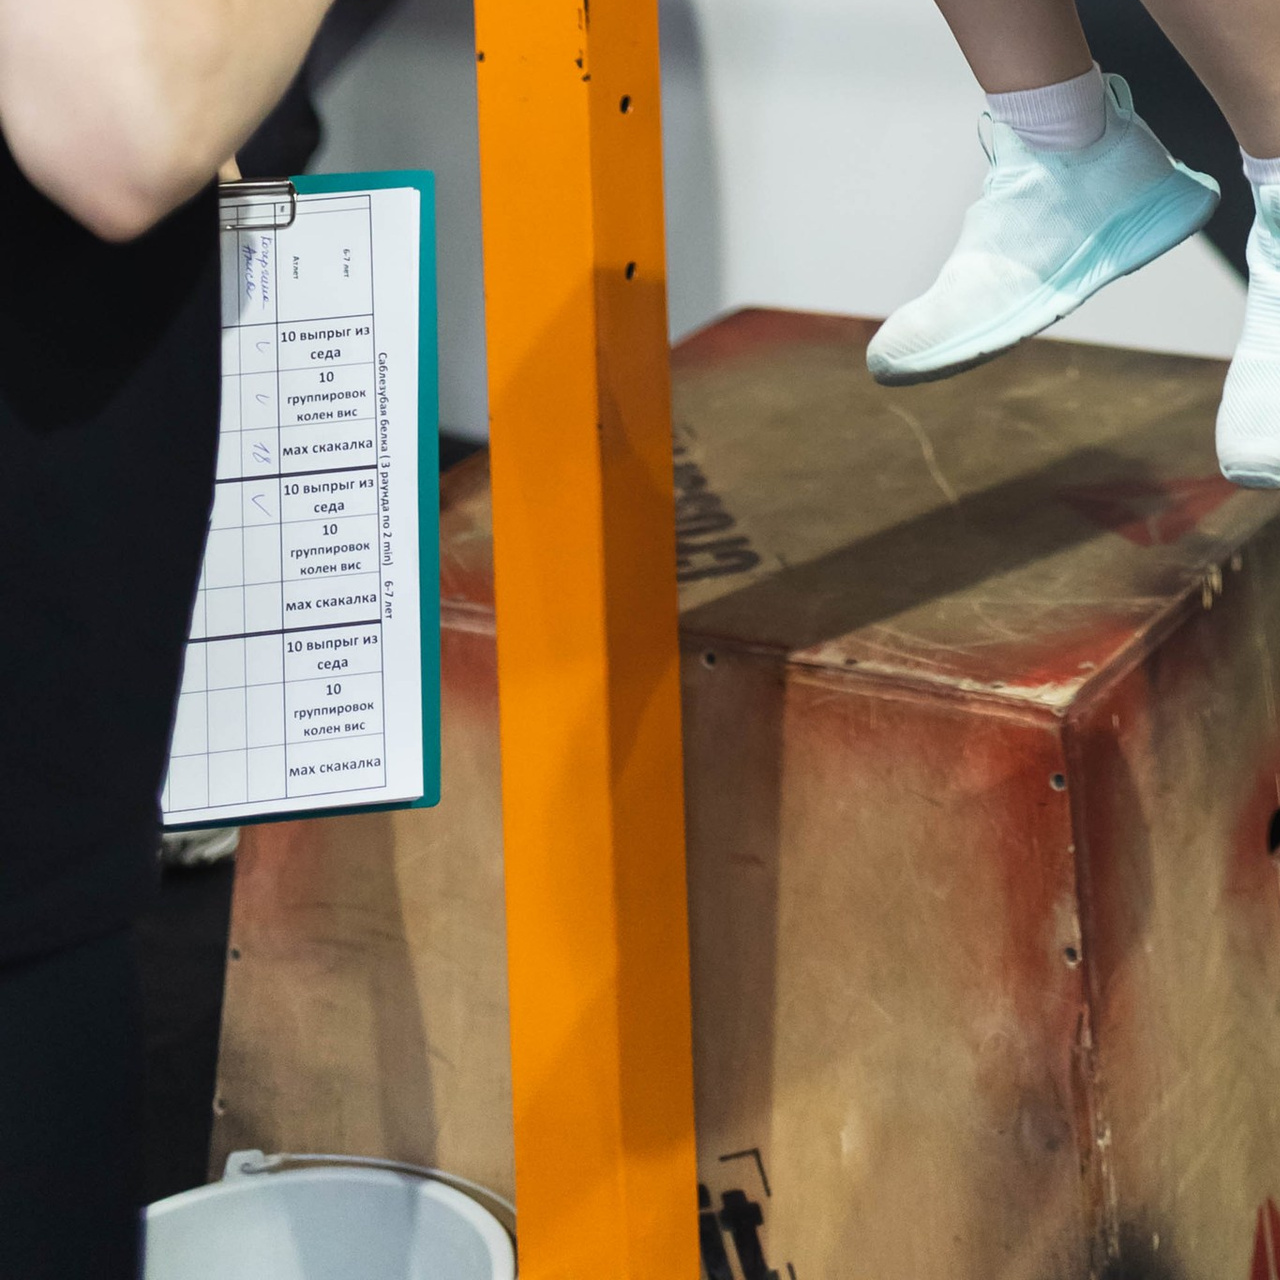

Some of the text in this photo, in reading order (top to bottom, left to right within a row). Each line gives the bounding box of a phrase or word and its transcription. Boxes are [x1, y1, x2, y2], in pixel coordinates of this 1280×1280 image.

[281, 325, 370, 343] 10 выпрыг из
[310, 347, 341, 361] седа
[319, 371, 335, 383] 10
[378, 352, 389, 416] Саблезубая
[287, 388, 367, 406] группировок
[296, 407, 358, 423] колен вис
[380, 419, 390, 452] белка
[312, 437, 373, 455] скакалка
[284, 478, 374, 496] 10 выпрыг из
[379, 472, 390, 512] раунда
[314, 500, 345, 514] седа
[322, 524, 338, 536] 10
[382, 515, 390, 529] по
[290, 541, 371, 560] группировок
[382, 541, 394, 566] min)
[300, 560, 362, 576] колен вис
[384, 580, 394, 598] 6-7
[315, 592, 377, 609] скакалка
[385, 601, 393, 619] лет
[287, 634, 379, 654] 10 выпрыг из
[317, 657, 349, 671] седа
[326, 683, 342, 696] 10
[294, 700, 375, 720] группировок
[303, 720, 366, 737] колен вис
[319, 756, 382, 774] скакалка
